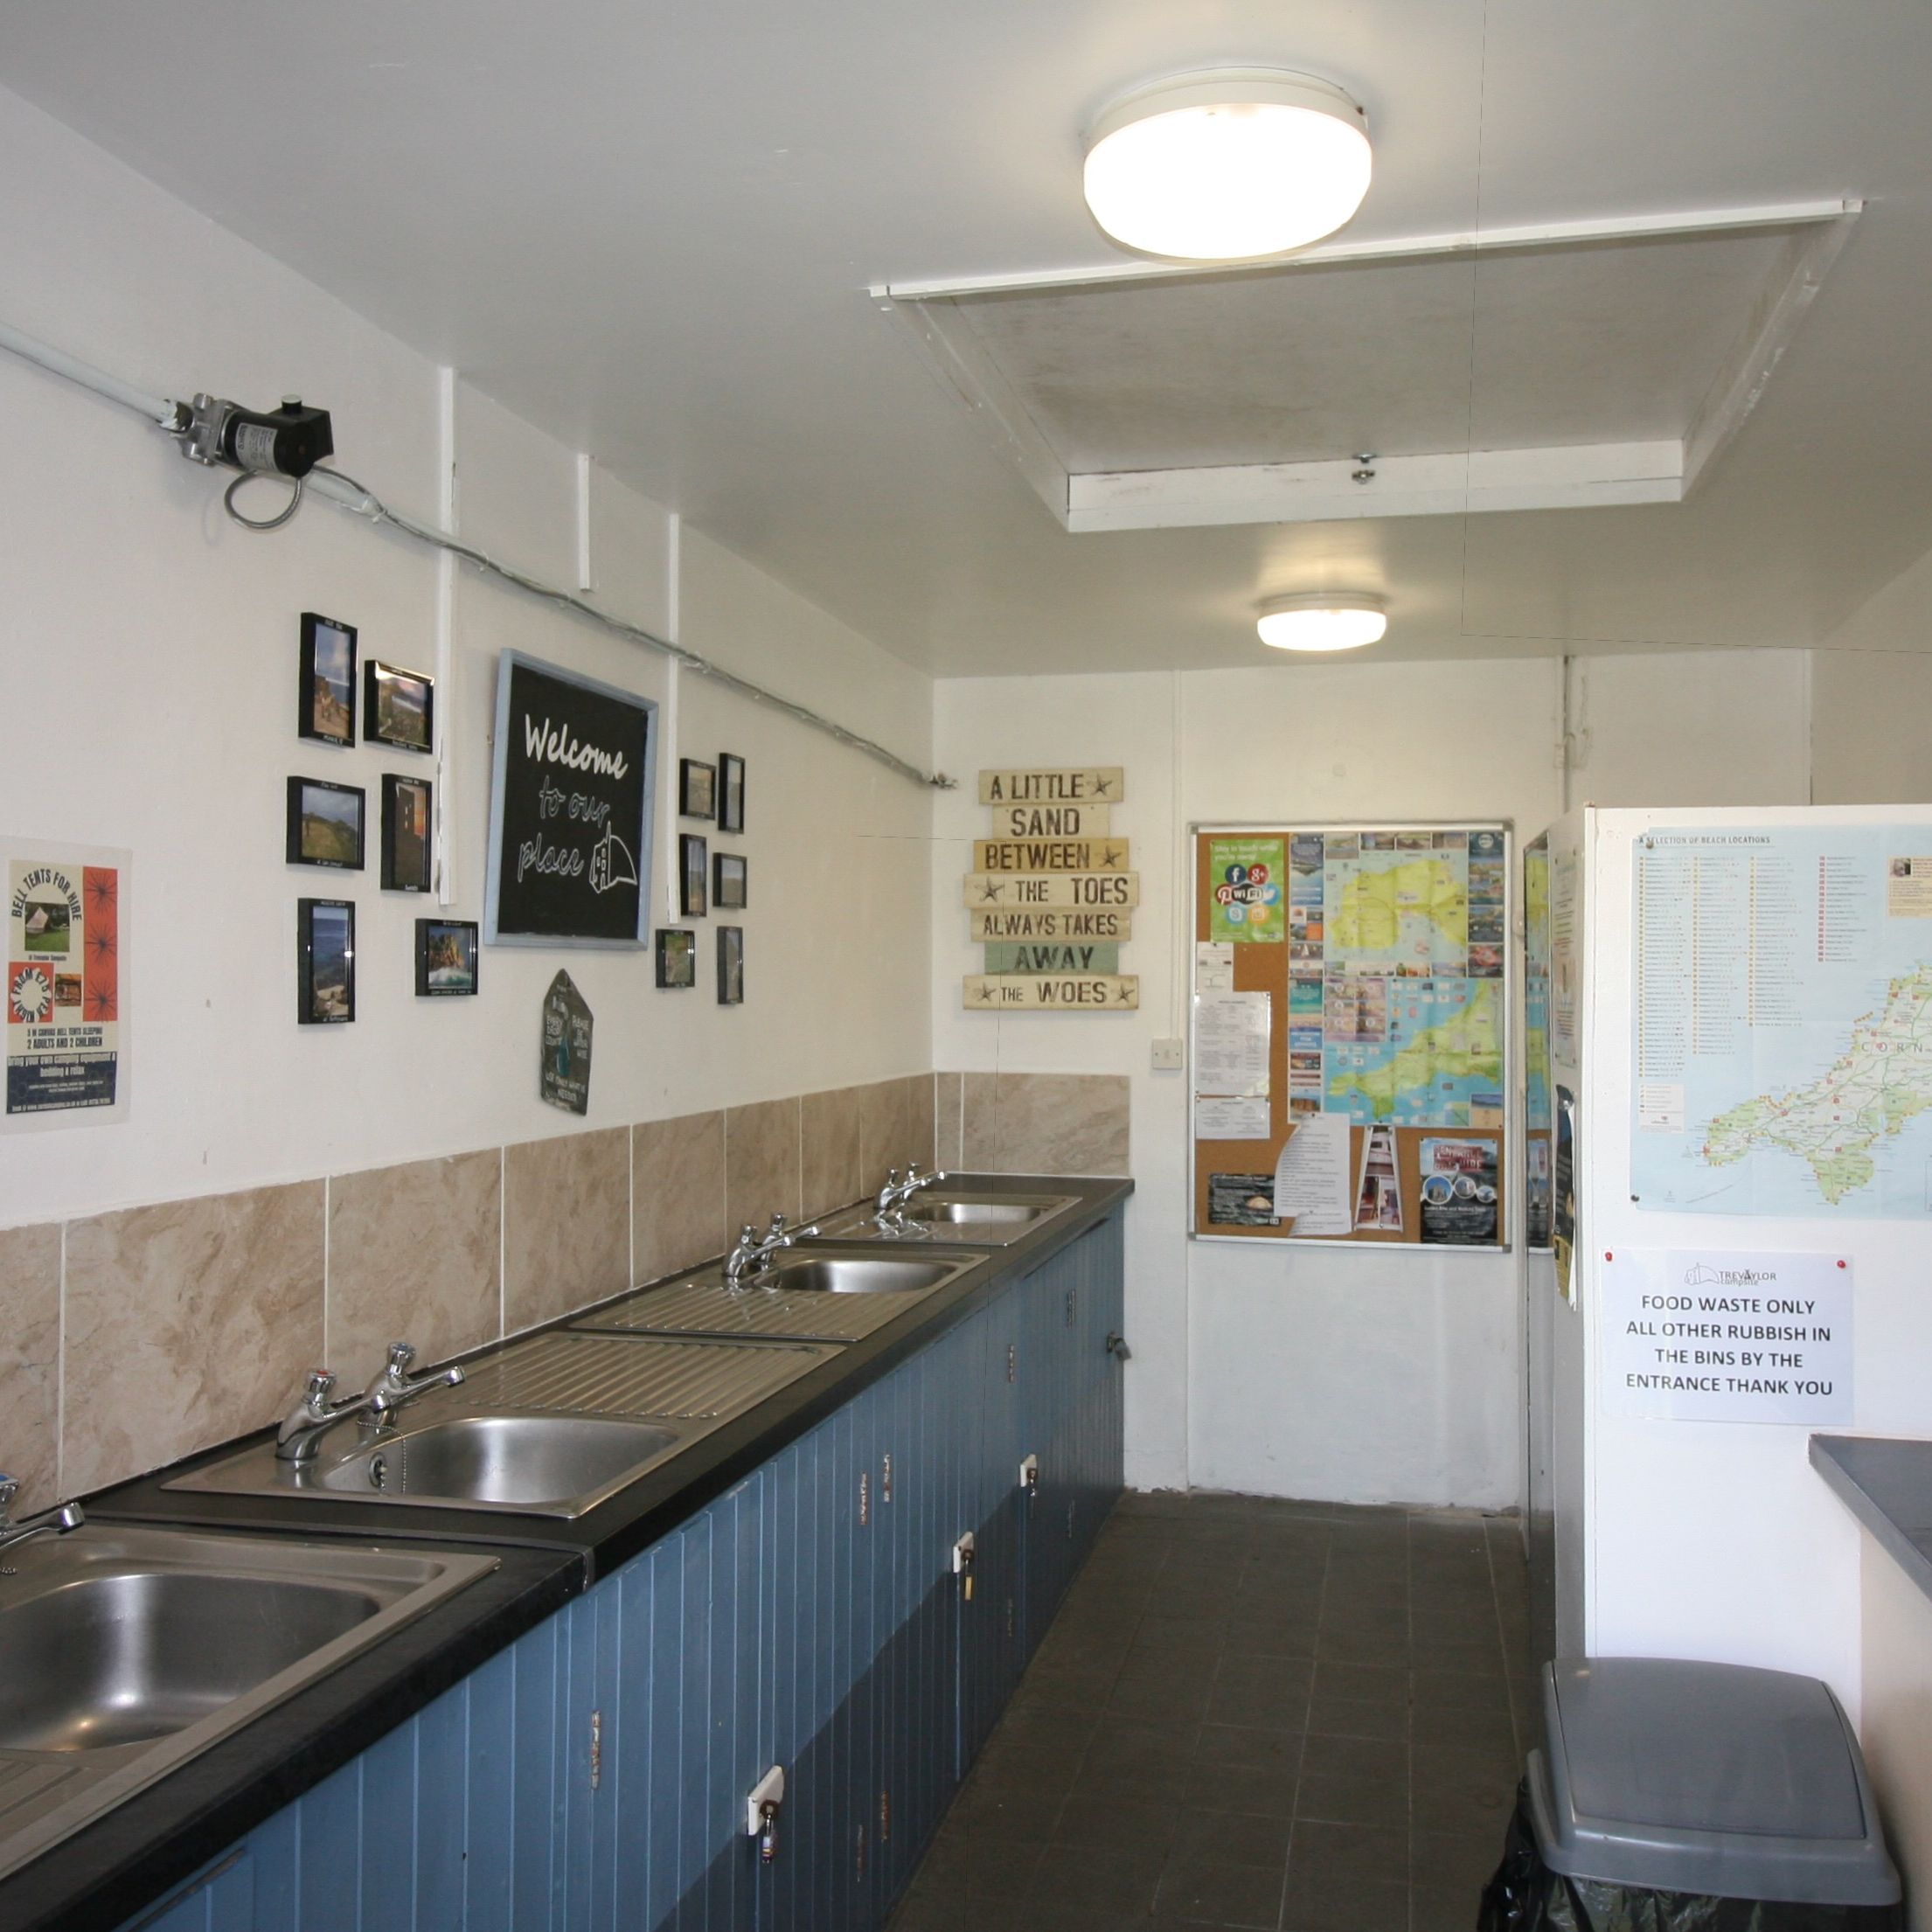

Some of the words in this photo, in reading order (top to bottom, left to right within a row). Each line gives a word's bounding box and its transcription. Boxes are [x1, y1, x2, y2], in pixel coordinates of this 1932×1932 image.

[525, 713, 629, 780] Welcome
[990, 775, 1003, 800] A
[1011, 774, 1084, 799] LITTLE
[539, 775, 566, 820] to
[568, 791, 611, 829] our
[1010, 807, 1081, 837] SAND
[1689, 836, 1698, 844] OF
[1701, 836, 1727, 844] BEACH
[1728, 836, 1771, 844] LOCATIONS
[518, 831, 585, 883] place
[984, 843, 1090, 871] BETWEEN
[11, 888, 28, 918] BELL
[23, 869, 51, 890] TENTS
[52, 872, 71, 894] FOR
[67, 892, 82, 921] HIRE
[1015, 880, 1049, 902] THE
[1071, 877, 1129, 905] TOES
[983, 914, 1056, 936] ALWAYS
[1062, 914, 1119, 935] TAKES
[1014, 946, 1095, 970] AWAY
[12, 968, 33, 995] FROM
[1001, 987, 1024, 1003] THE
[1037, 981, 1108, 1004] WOES
[27, 1039, 31, 1049] 2
[33, 1038, 55, 1049] ADULTS
[56, 1038, 68, 1048] AND
[70, 1037, 73, 1047] 2
[75, 1036, 102, 1047] CHILDREN
[1719, 1269, 1777, 1282] TREVAYLOR
[1641, 1295, 1692, 1311] FOOD
[1698, 1297, 1762, 1313] WASTE
[1766, 1299, 1816, 1315] ONLY
[1626, 1320, 1657, 1336] ALL
[1662, 1322, 1722, 1338] OTHER
[1727, 1324, 1806, 1341] RUBBISH
[1812, 1327, 1831, 1342] IN
[1654, 1348, 1689, 1364] THE
[1694, 1350, 1735, 1366] BINS
[1741, 1352, 1763, 1366] BY
[1768, 1352, 1803, 1368] THE
[1626, 1373, 1720, 1392] ENTRANCE
[1725, 1378, 1789, 1394] THANK
[1794, 1380, 1833, 1395] YOU
